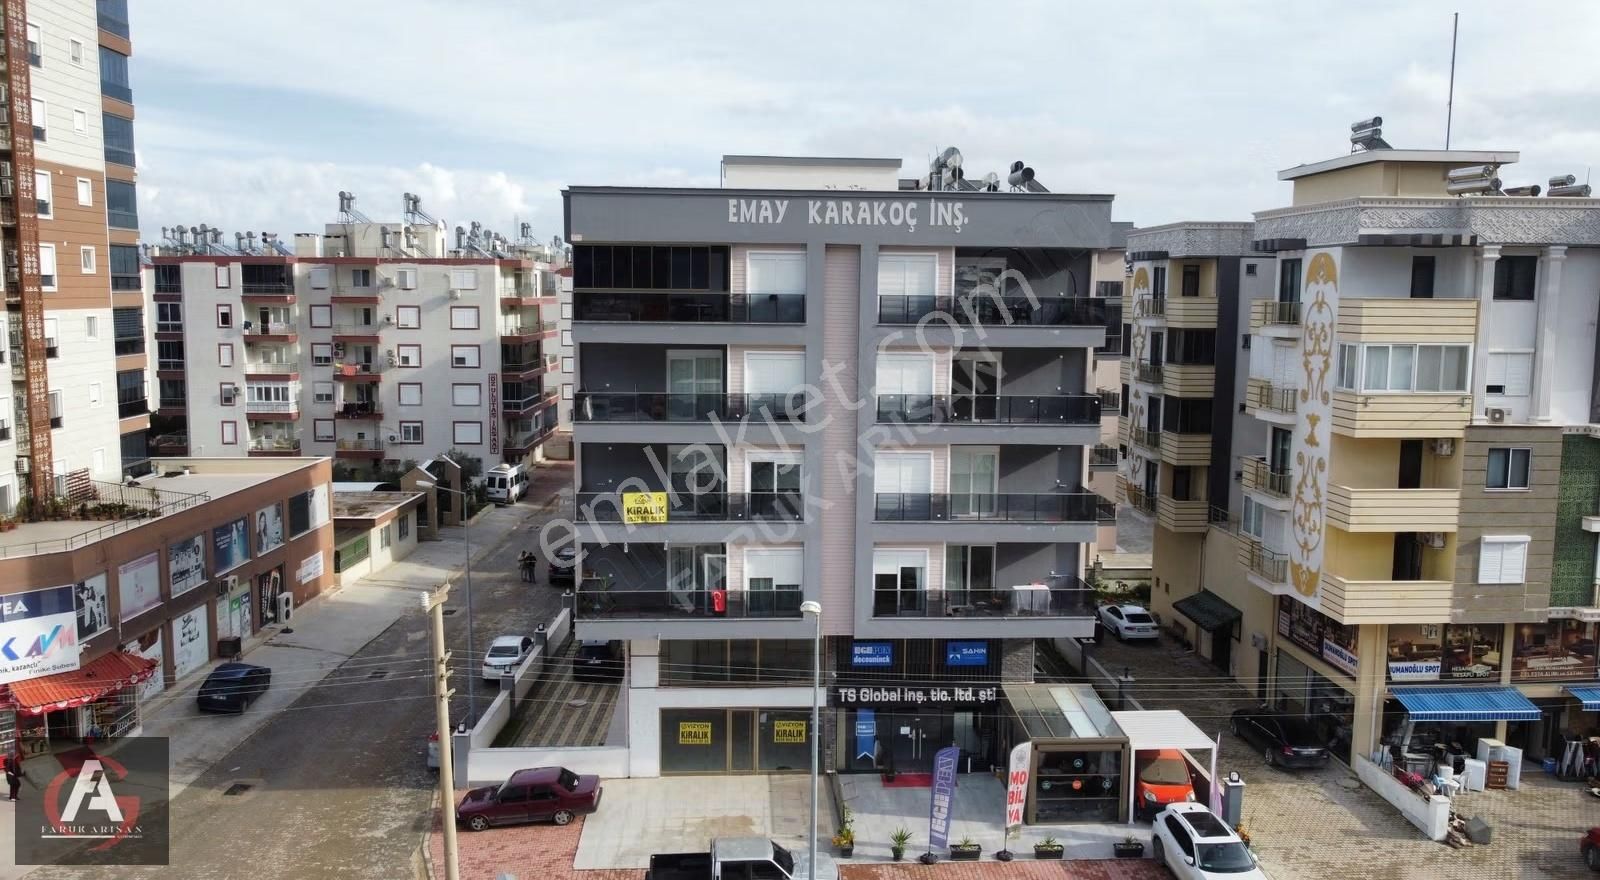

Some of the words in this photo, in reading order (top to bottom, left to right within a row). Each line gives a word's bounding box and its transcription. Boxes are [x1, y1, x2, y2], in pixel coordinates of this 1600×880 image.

[728, 199, 789, 223] EMAY
[808, 201, 917, 232] KARAKOÇ
[929, 198, 968, 233] İNŞ.
[1424, 665, 1440, 673] SPOT
[839, 688, 856, 702] TS
[860, 687, 900, 702] Global
[955, 687, 976, 702] ltd.
[1010, 771, 1027, 785] MO
